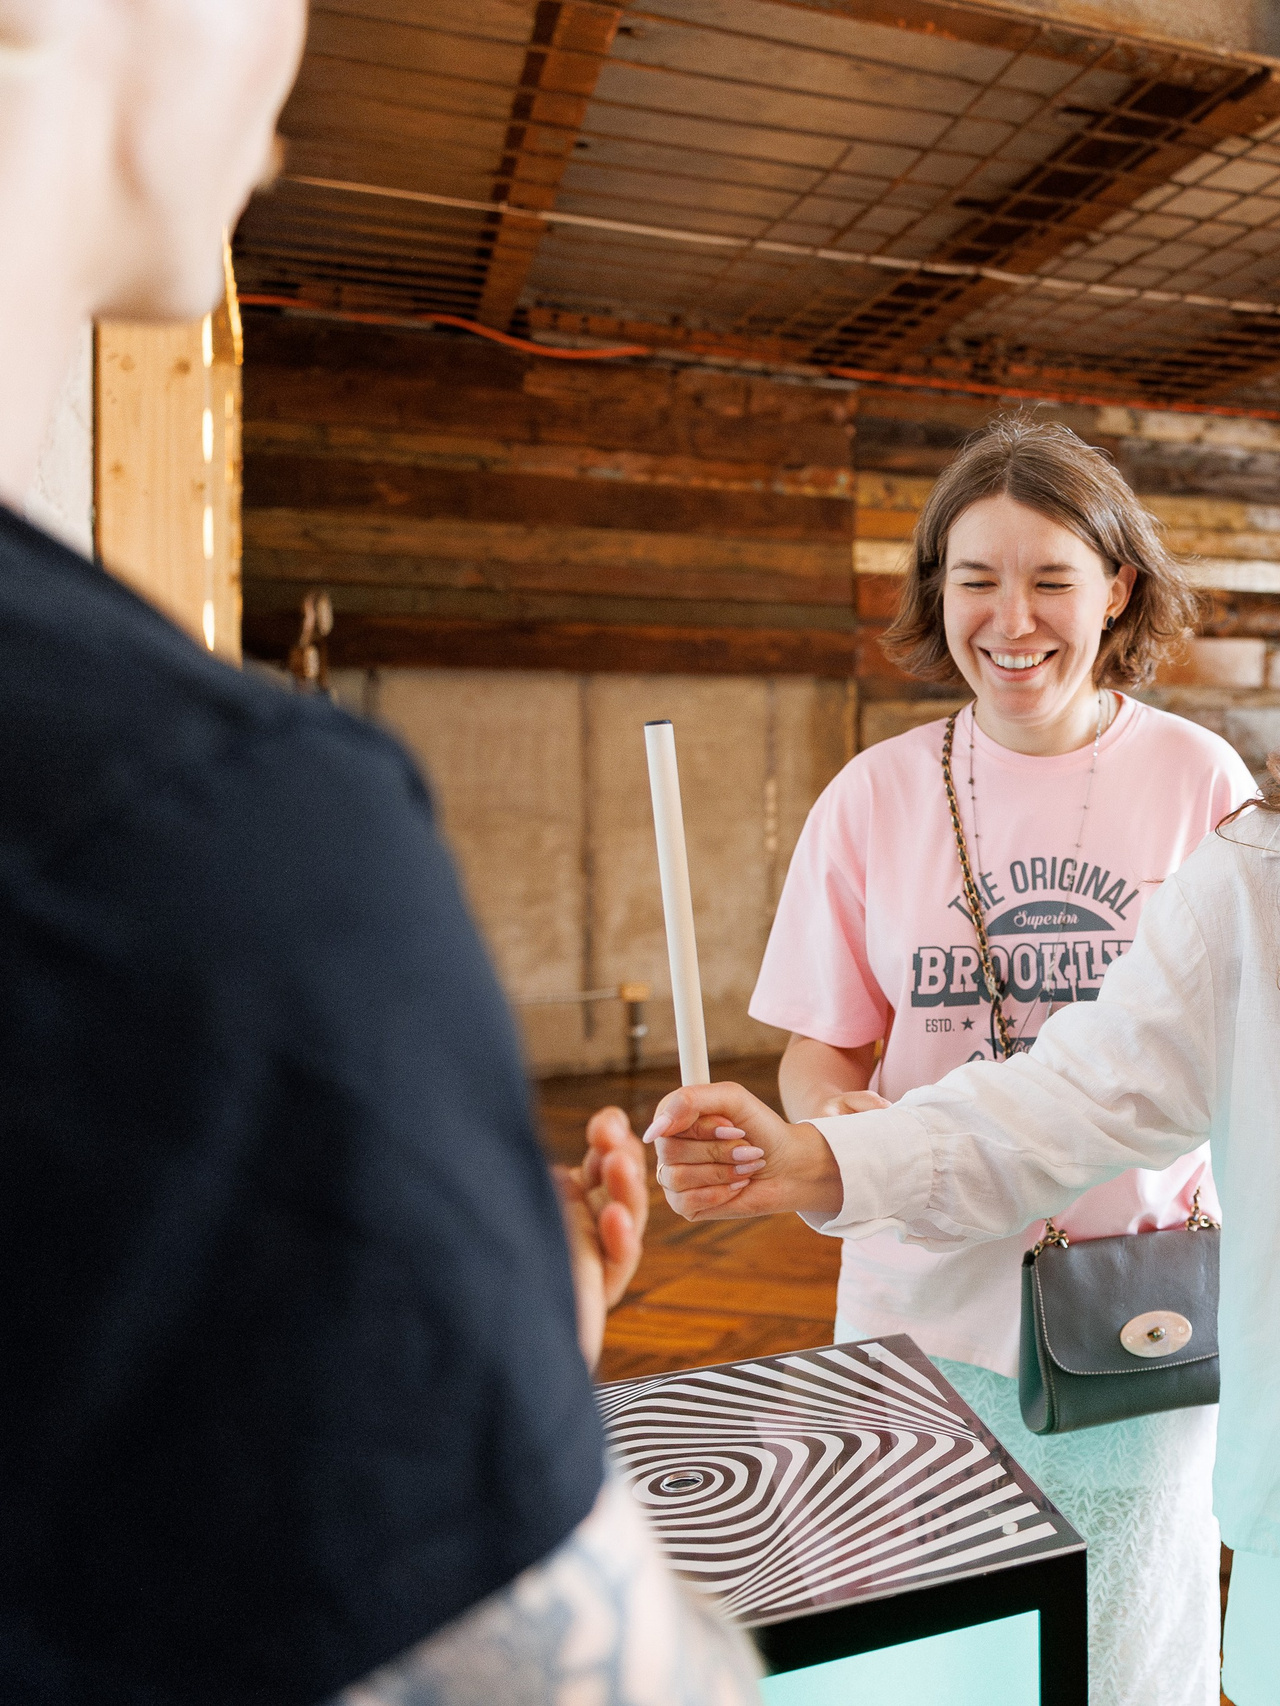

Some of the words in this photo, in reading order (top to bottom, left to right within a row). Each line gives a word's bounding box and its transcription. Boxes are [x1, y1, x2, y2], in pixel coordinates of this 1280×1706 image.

[1009, 856, 1140, 921] ORIGINAL
[1013, 910, 1079, 930] Superior
[925, 1018, 956, 1033] ESTD.
